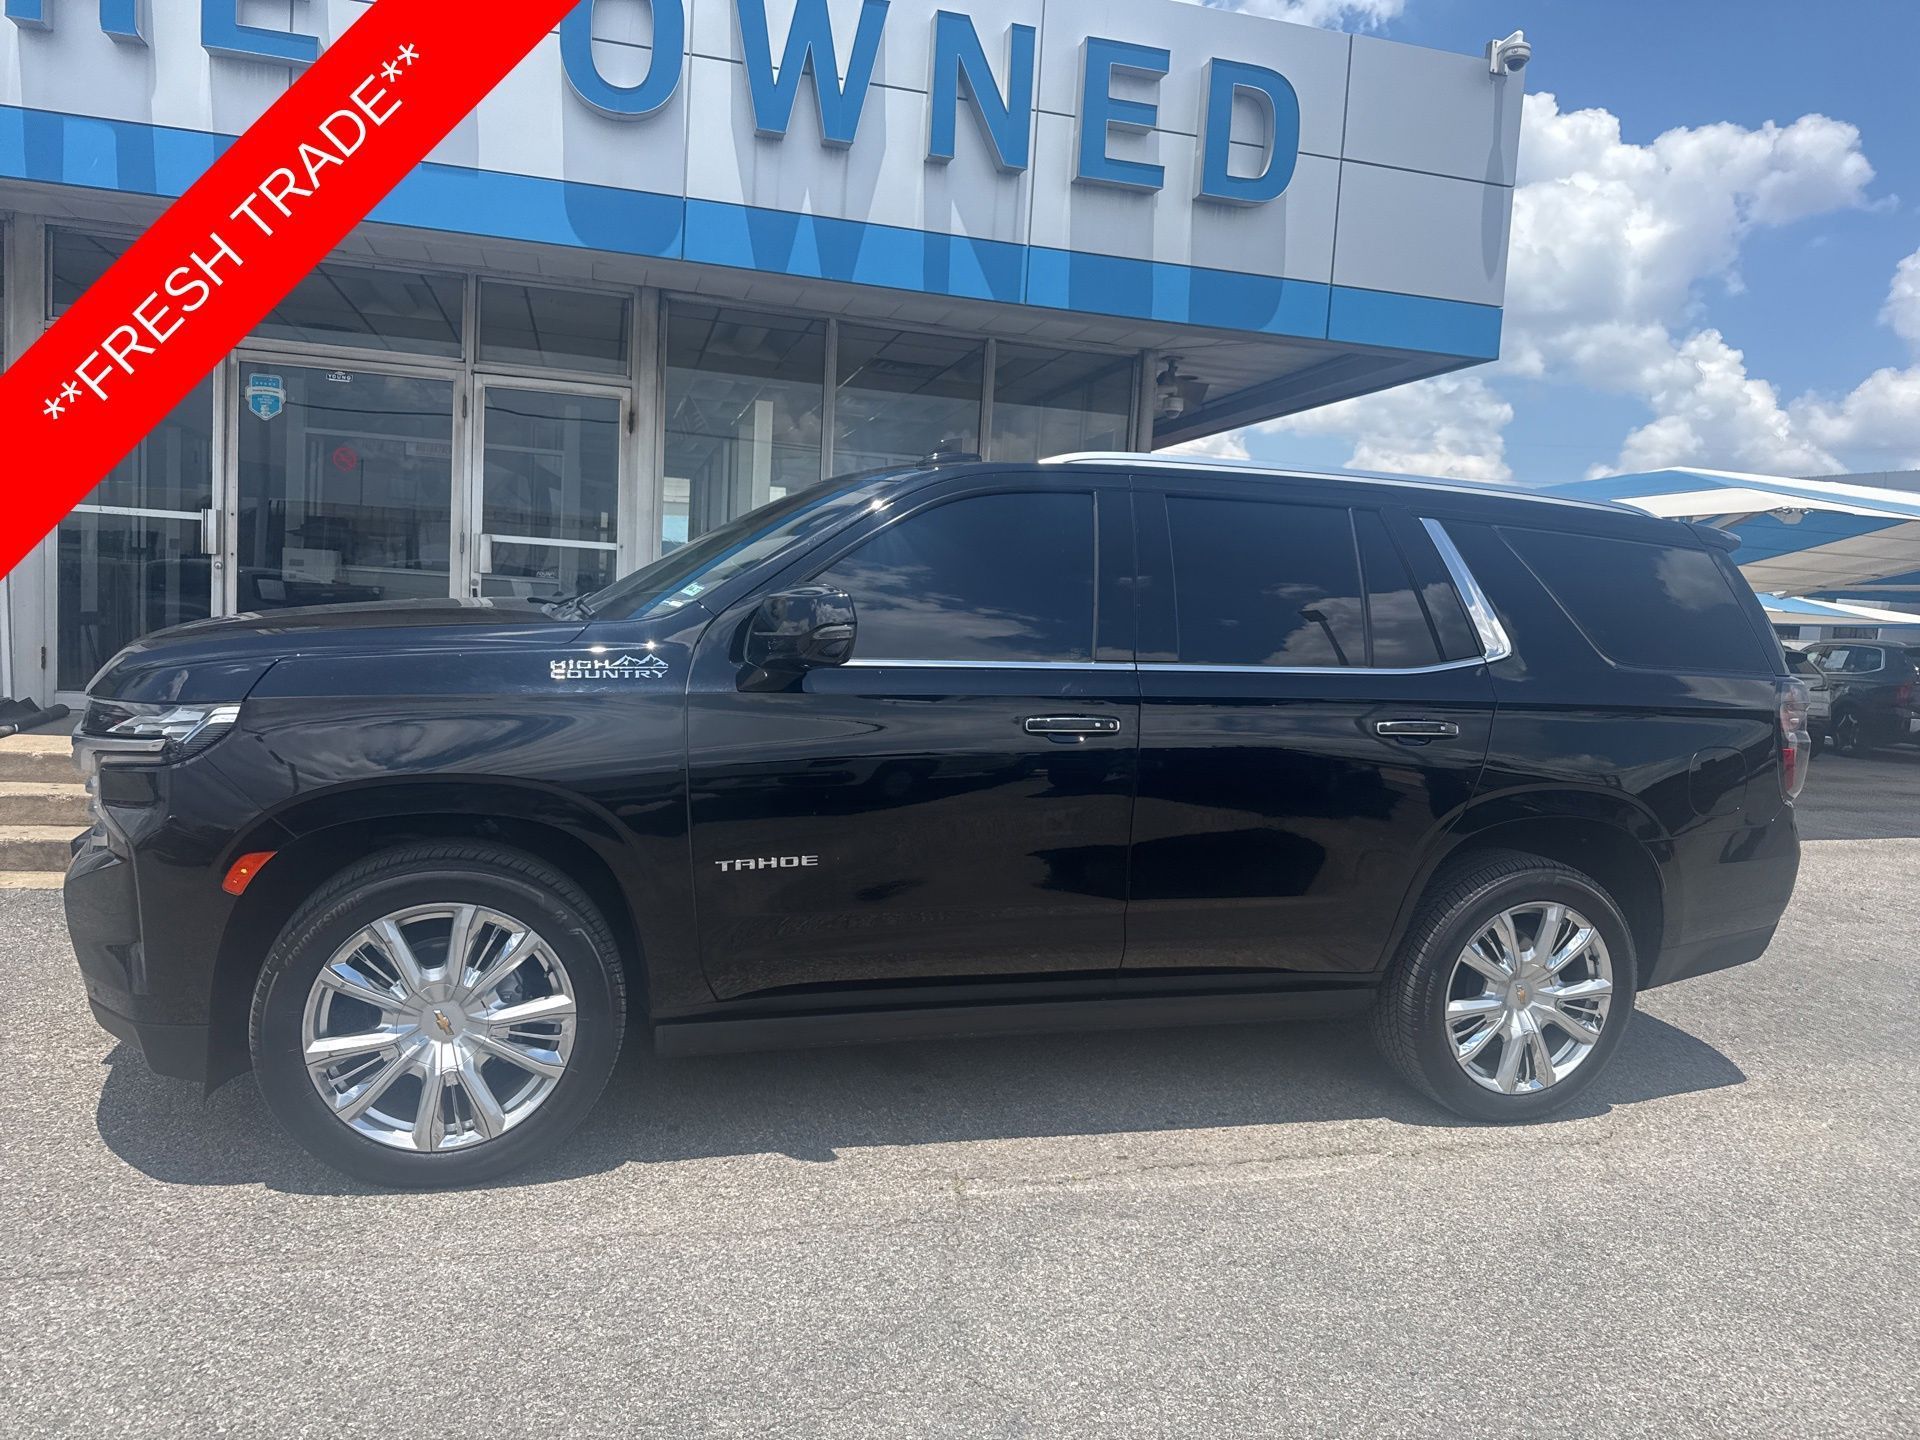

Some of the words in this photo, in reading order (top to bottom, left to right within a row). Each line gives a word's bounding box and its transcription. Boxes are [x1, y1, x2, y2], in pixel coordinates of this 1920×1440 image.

[560, 0, 1301, 206] OWNED
[550, 659, 609, 669] HIGH
[550, 669, 668, 680] COUNTRY
[715, 855, 819, 872] TAHOE
